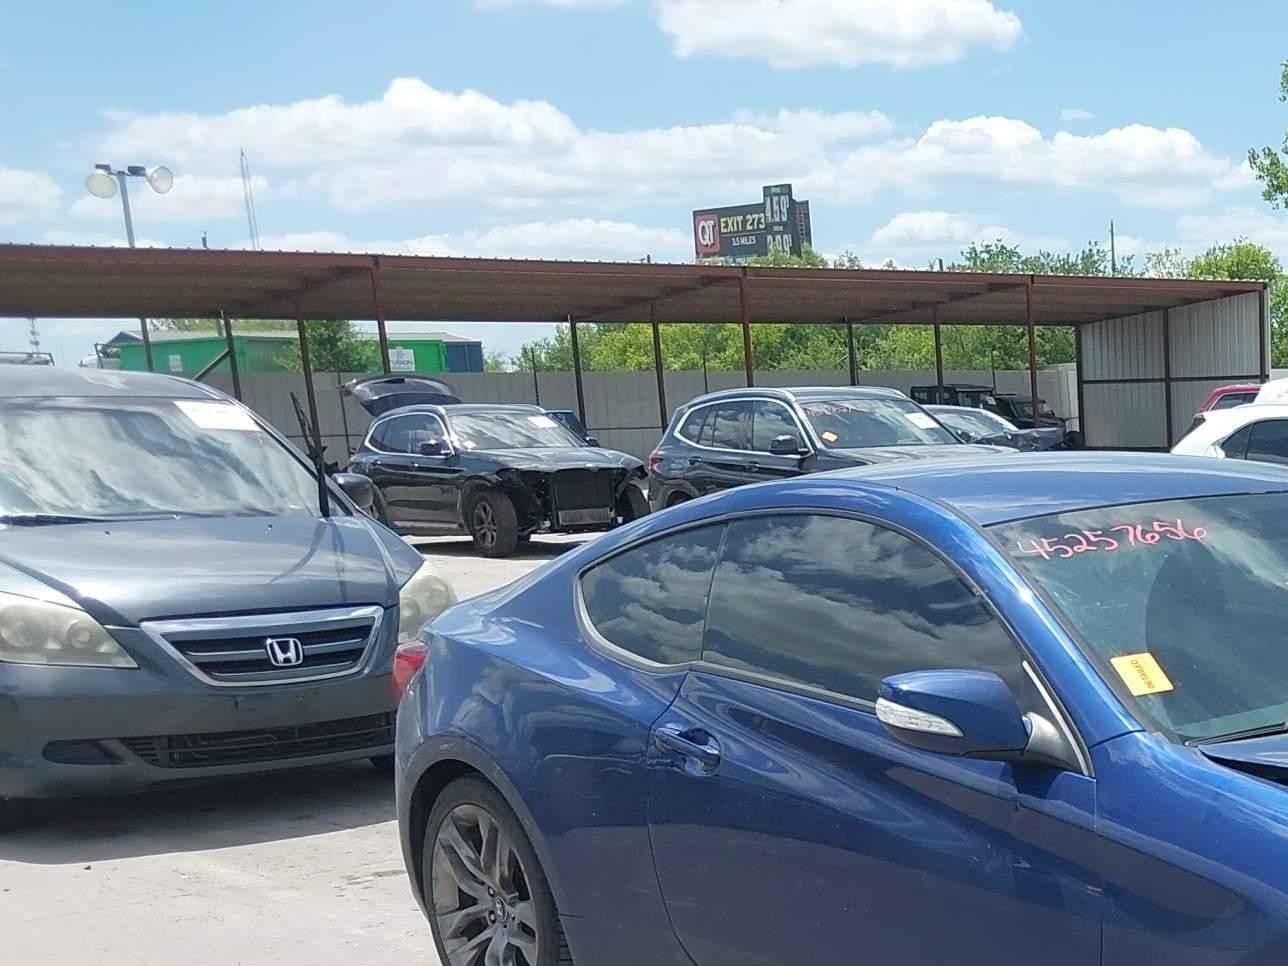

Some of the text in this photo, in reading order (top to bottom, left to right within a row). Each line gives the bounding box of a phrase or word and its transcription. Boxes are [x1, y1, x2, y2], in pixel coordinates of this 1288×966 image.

[698, 220, 717, 247] QT
[720, 213, 766, 233] EXIT 273
[741, 235, 757, 246] MILES
[1017, 519, 1207, 560] 45257656
[1130, 658, 1156, 689] DETAILED
